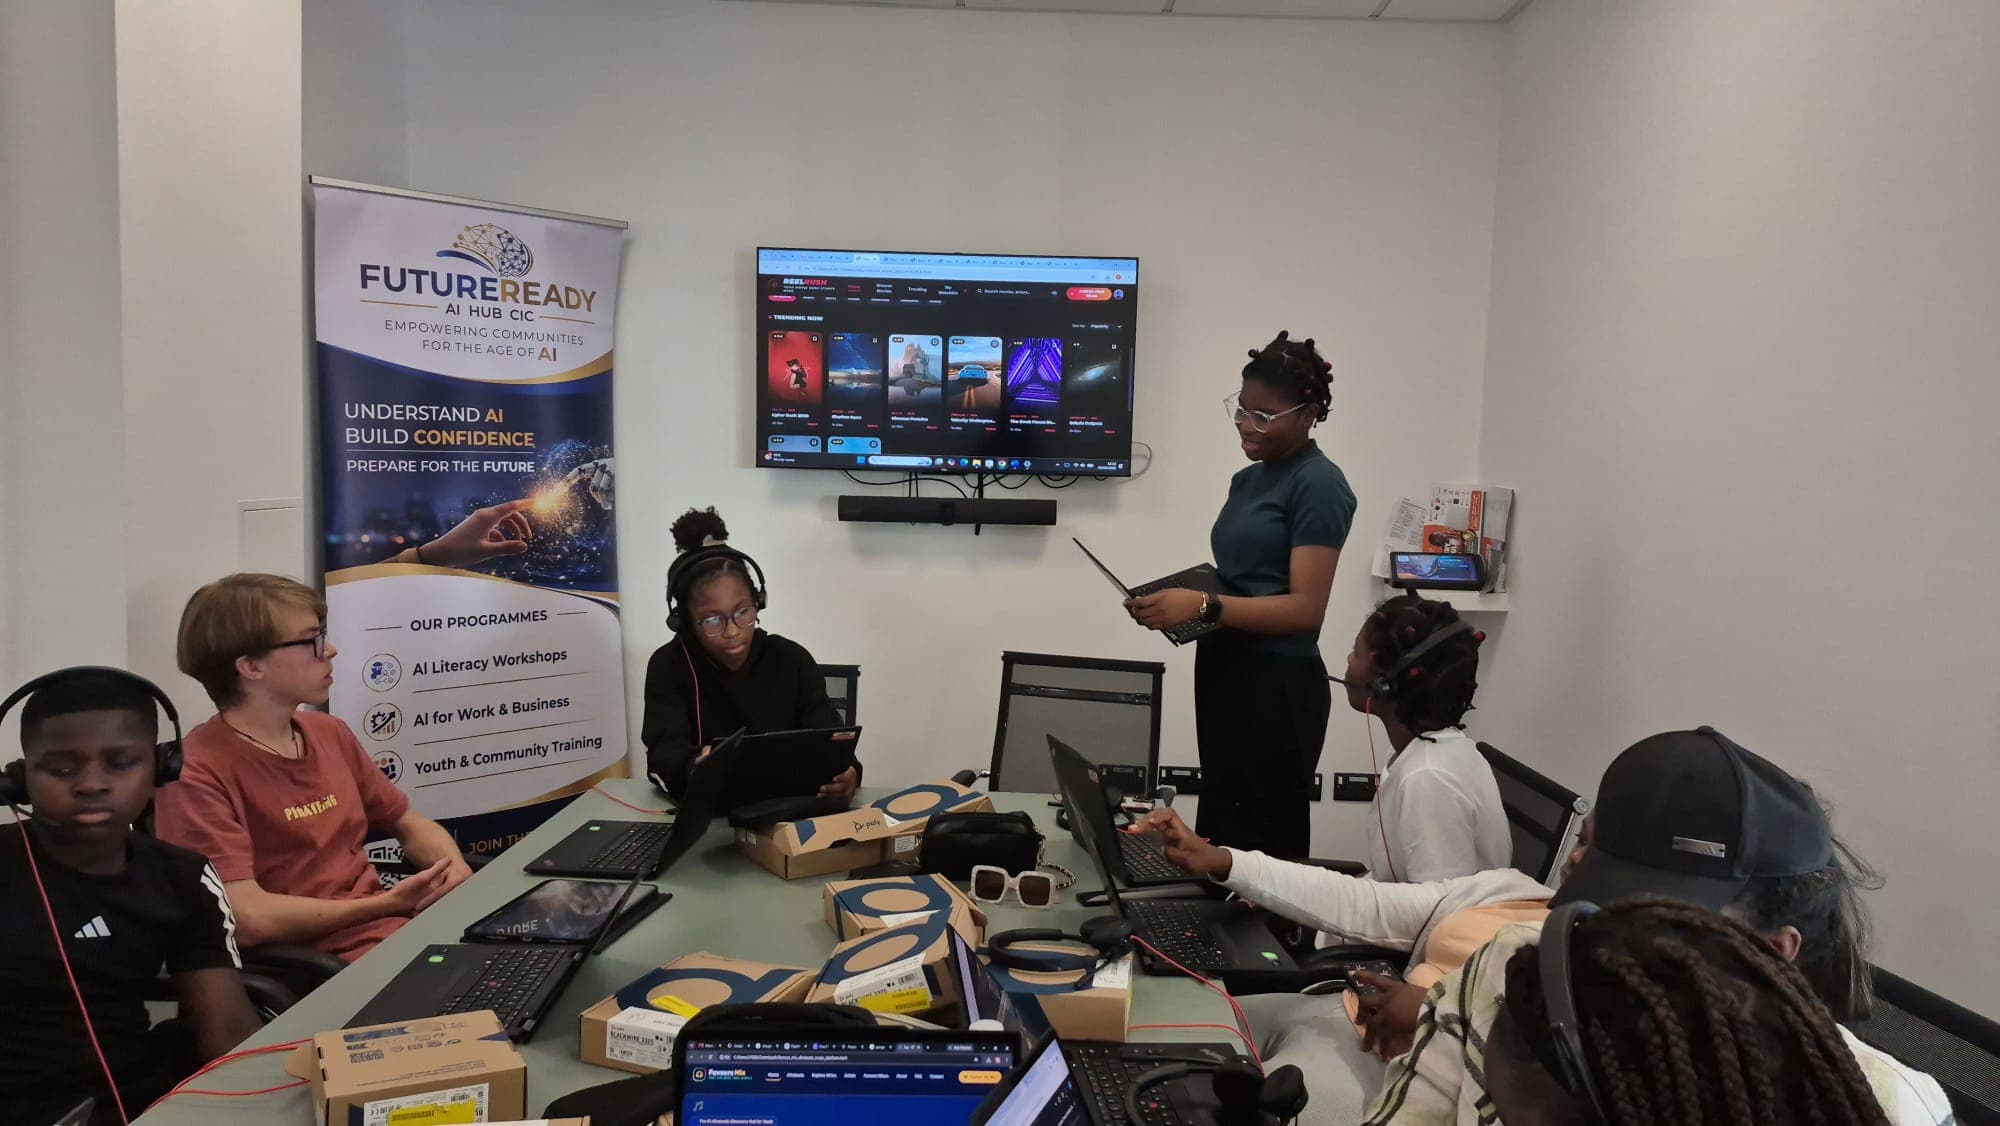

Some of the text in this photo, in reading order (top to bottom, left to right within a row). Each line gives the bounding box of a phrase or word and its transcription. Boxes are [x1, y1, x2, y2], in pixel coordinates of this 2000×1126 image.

[445, 303, 535, 322] AI HUB CIC
[385, 319, 584, 346] EMPOWERING COMMUNITIES
[422, 339, 557, 362] FOR THE AGE OF AI
[345, 403, 503, 423] UNDERSTAND AI
[346, 428, 535, 448] BUILD CONFIDENCE
[346, 460, 535, 473] PREPARE FOR THE FUTURE
[410, 610, 548, 632] OUR PROGRAMMES
[413, 649, 568, 677] AI Literacy Workshops
[414, 696, 570, 727] AI for Work & Business
[414, 736, 603, 775] Youth & Community Training
[470, 831, 530, 855] JOIN TH
